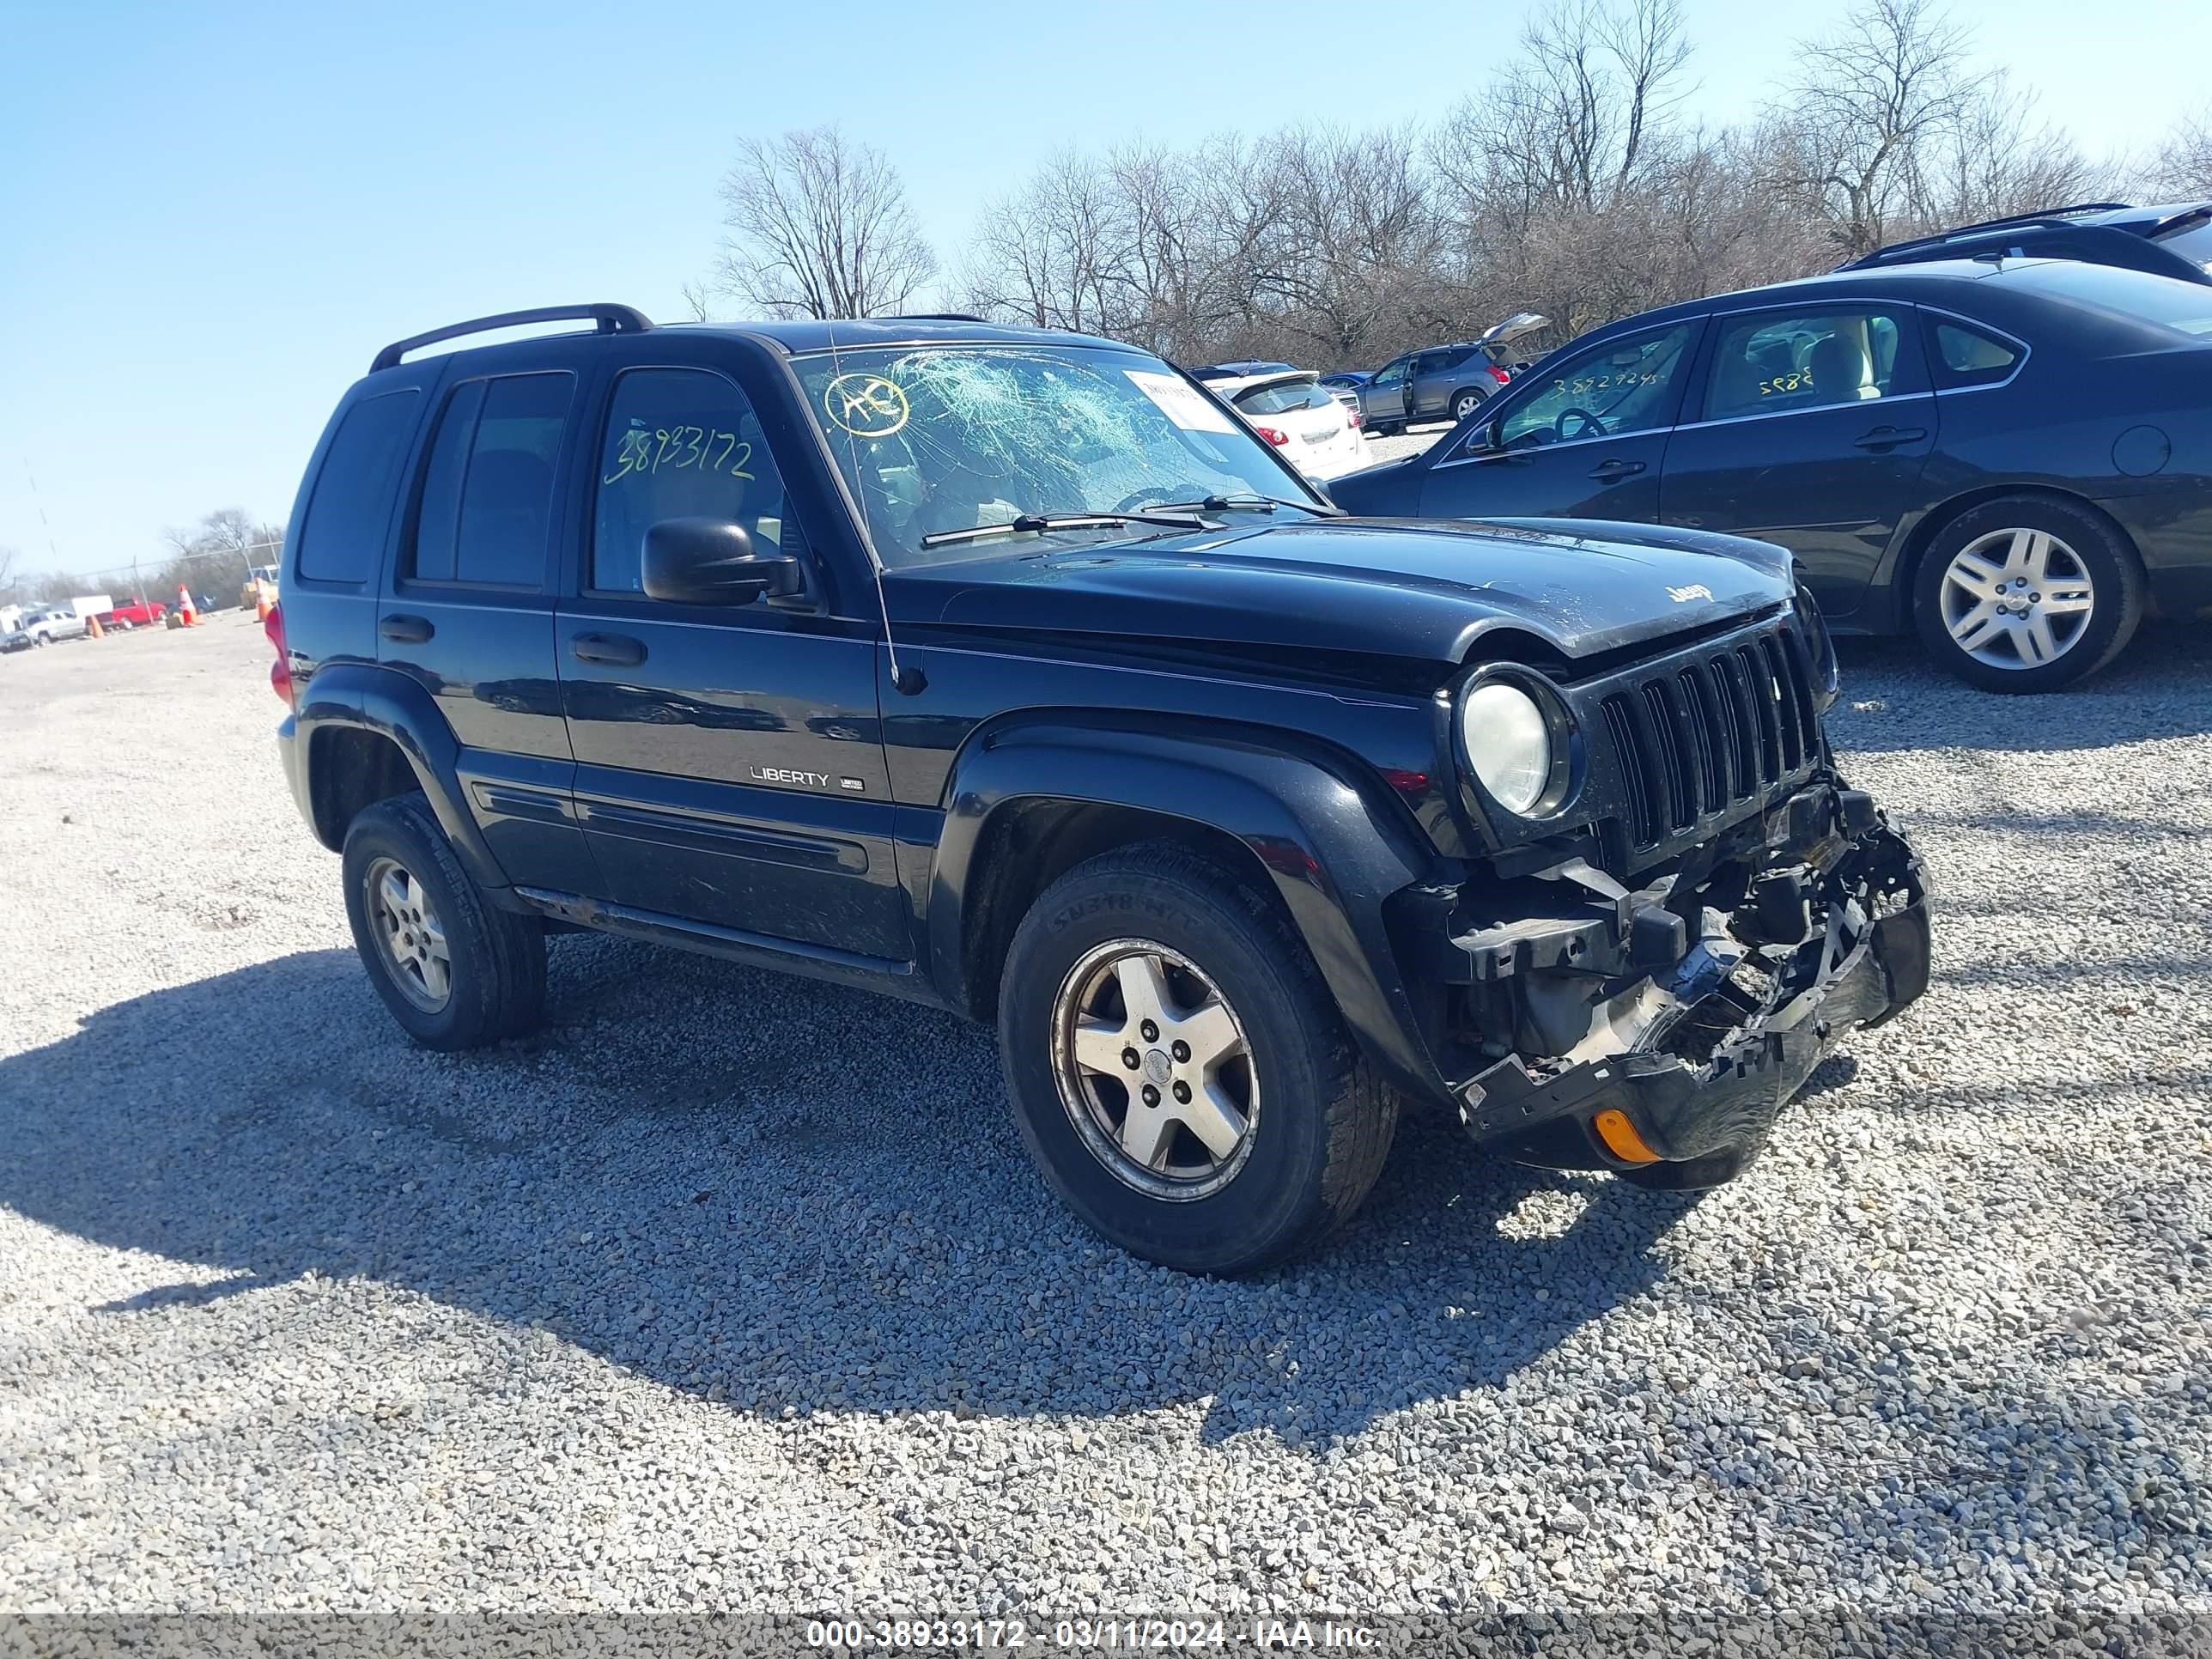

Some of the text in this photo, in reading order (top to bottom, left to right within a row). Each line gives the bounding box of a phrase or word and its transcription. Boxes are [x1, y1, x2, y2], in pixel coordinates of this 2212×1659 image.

[604, 425, 756, 485] 38933172
[1665, 584, 1715, 603] Jeep
[750, 765, 830, 787] LIBERTY
